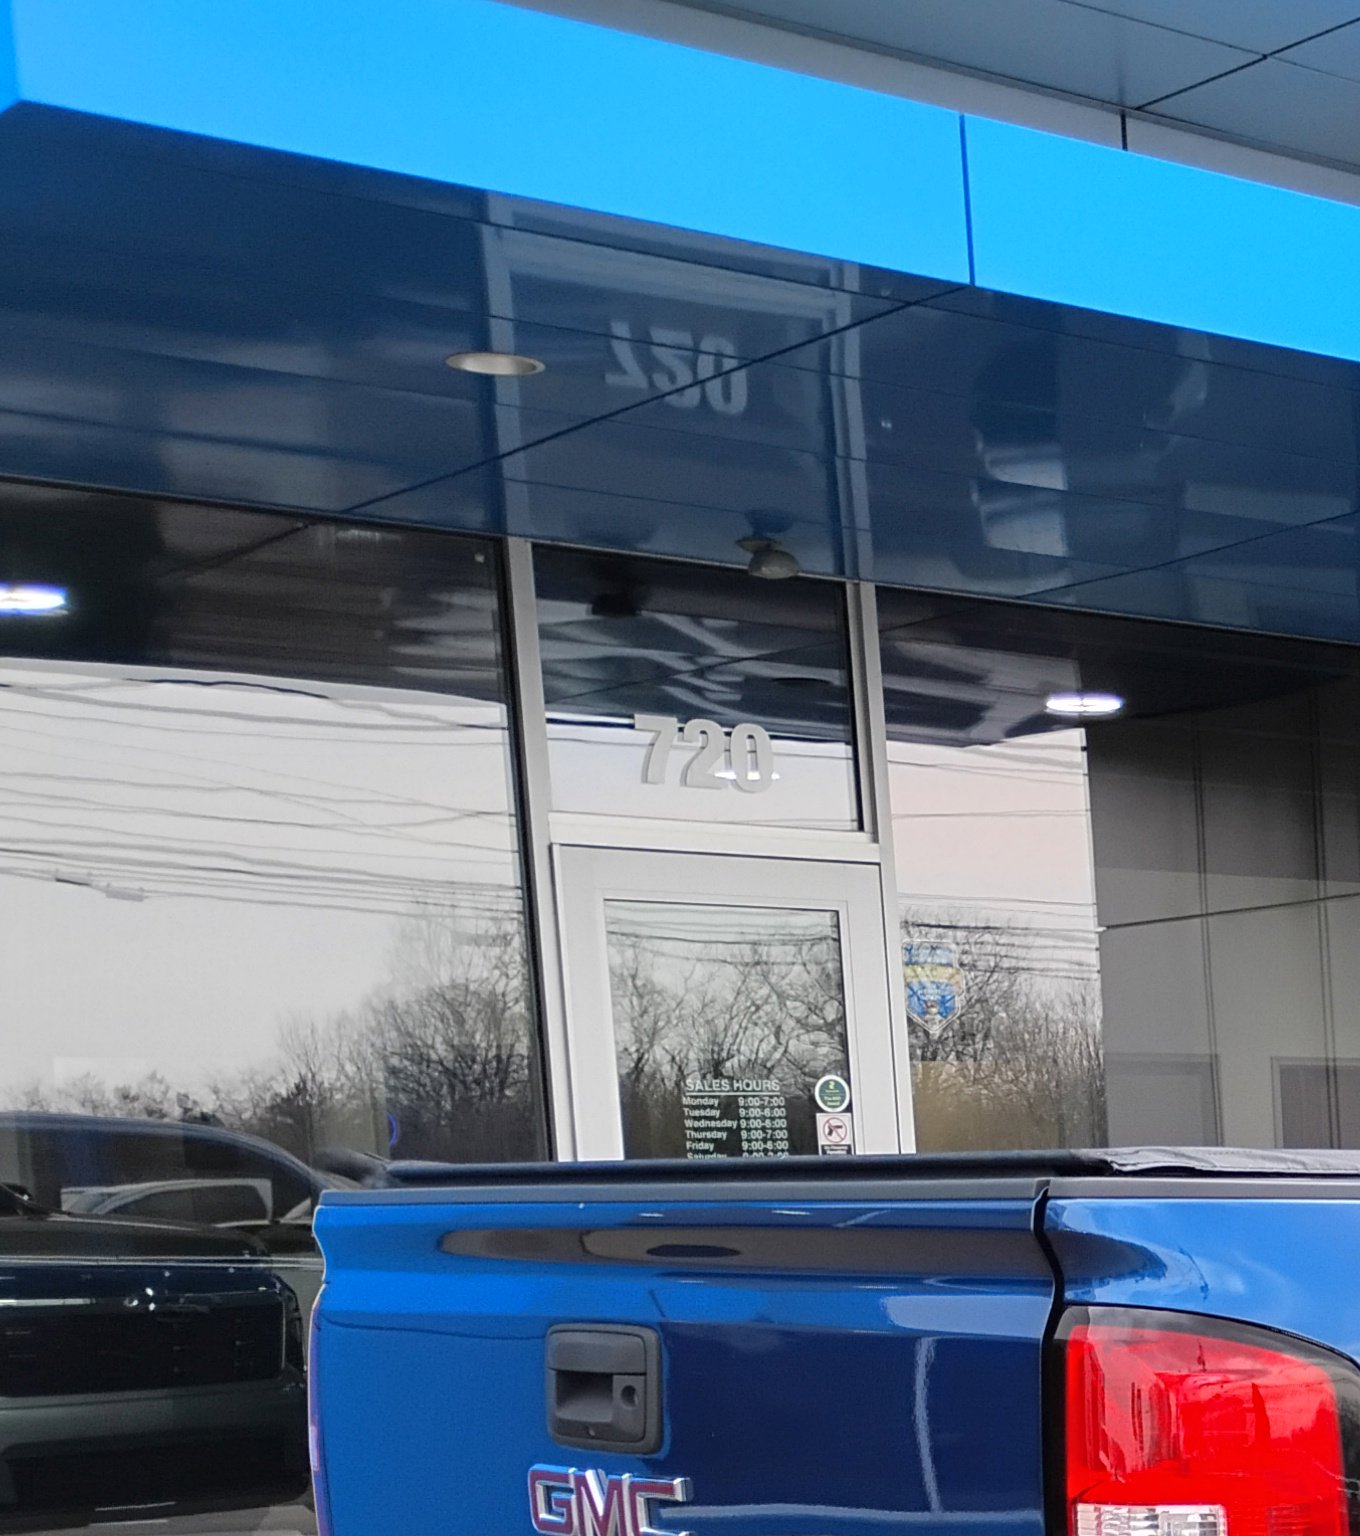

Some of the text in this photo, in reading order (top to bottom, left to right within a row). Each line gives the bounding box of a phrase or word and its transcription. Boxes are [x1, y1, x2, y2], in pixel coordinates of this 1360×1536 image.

[633, 713, 774, 793] 720
[685, 1079, 781, 1091] SALES HOURS
[682, 1096, 786, 1107] Monday 9:00-7:00
[683, 1107, 721, 1118] Tuesday
[684, 1119, 738, 1130] Wednesday
[685, 1129, 789, 1141] Thursday 9:00-7:00
[686, 1141, 715, 1152] Friday
